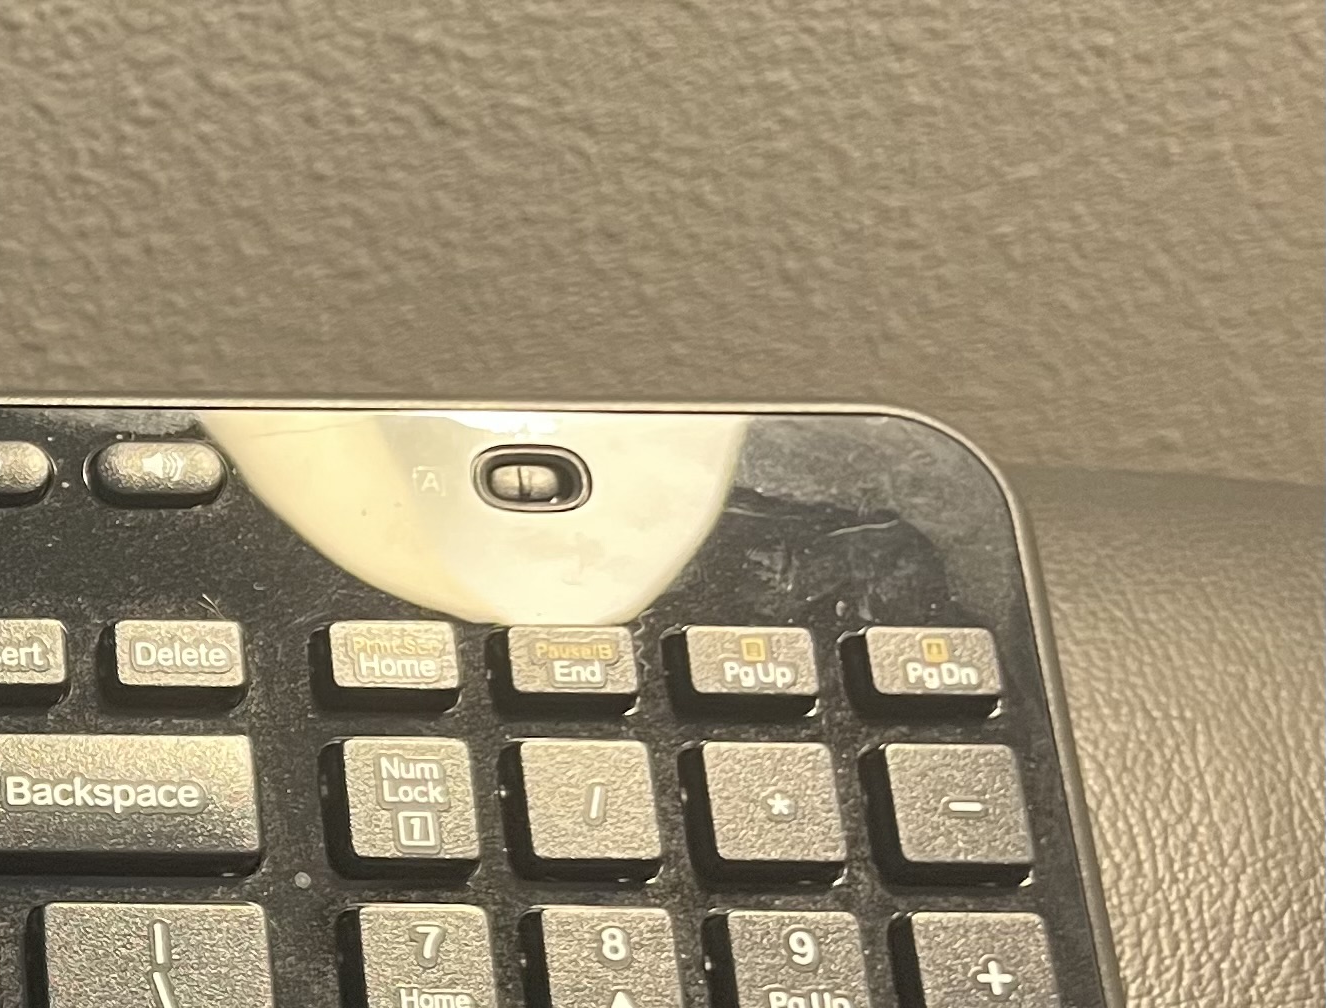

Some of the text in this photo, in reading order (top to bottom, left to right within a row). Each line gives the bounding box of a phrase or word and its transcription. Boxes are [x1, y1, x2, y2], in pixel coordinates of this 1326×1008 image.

[135, 641, 227, 669] Delete
[359, 654, 437, 677] Home
[553, 660, 602, 683] End
[380, 757, 439, 779] Num
[5, 777, 201, 814] Backspace
[383, 780, 444, 803] Lock
[416, 926, 441, 962] 7
[601, 928, 626, 962] 8
[790, 931, 816, 966] 9
